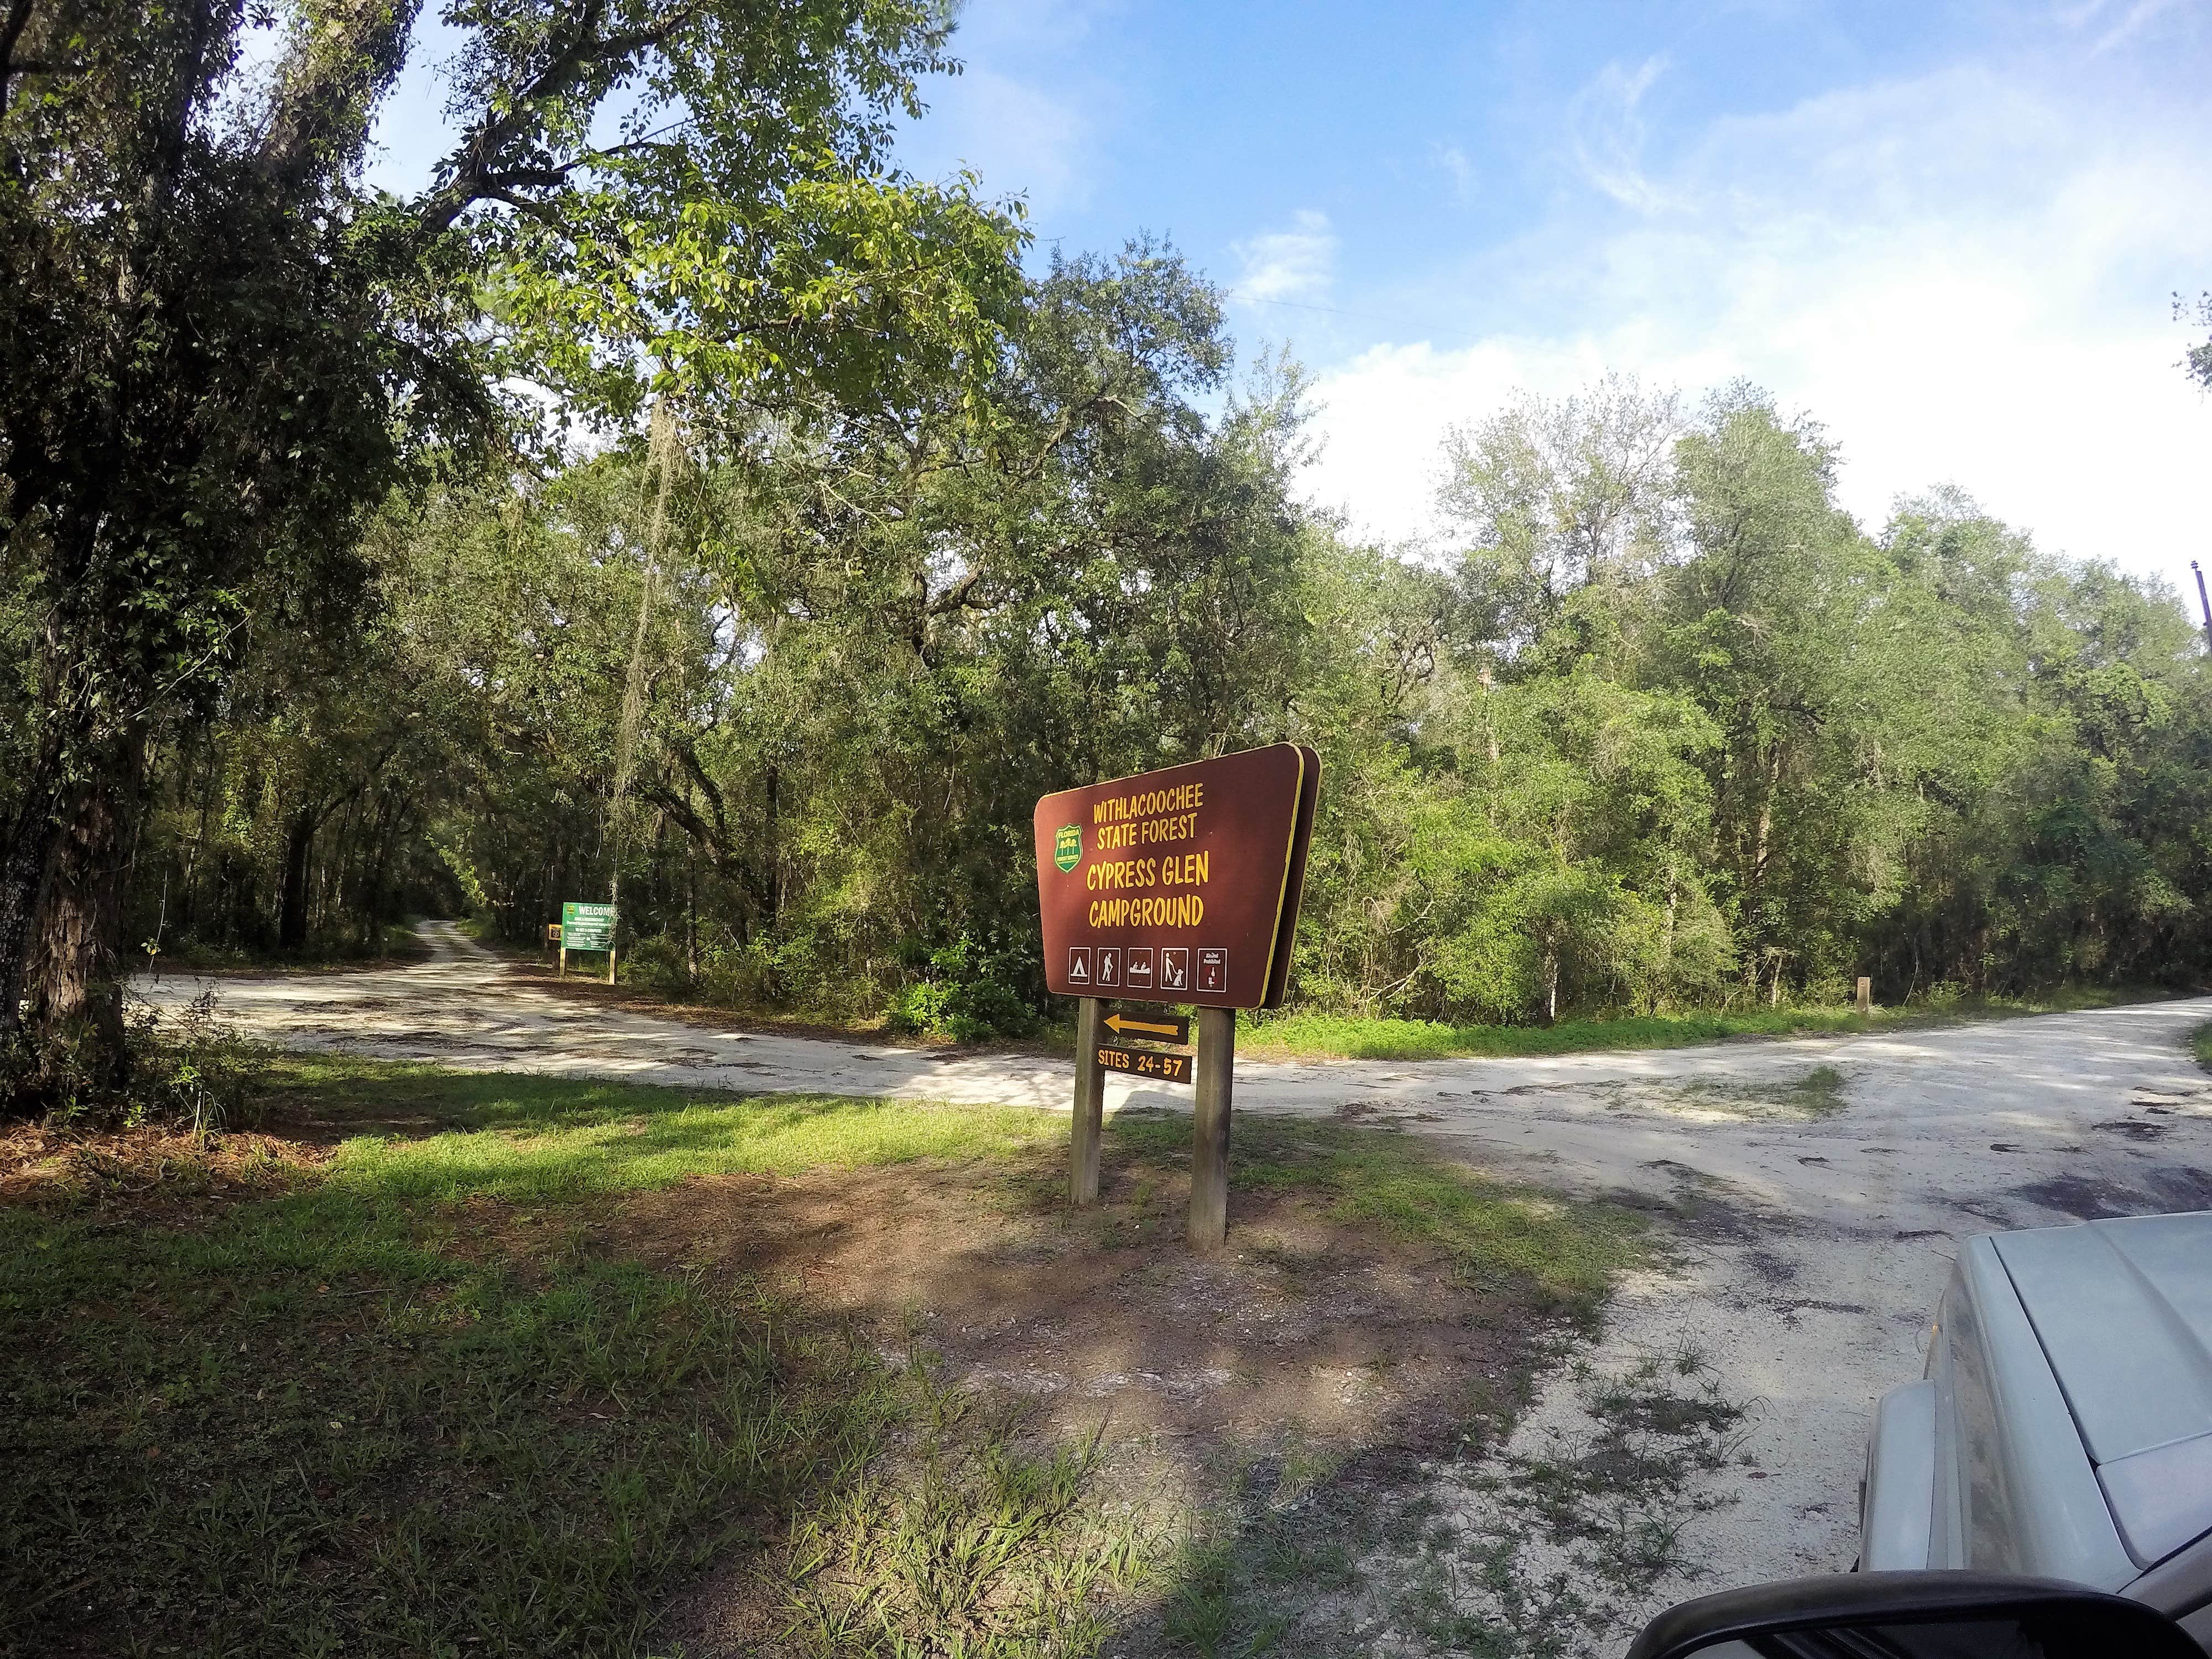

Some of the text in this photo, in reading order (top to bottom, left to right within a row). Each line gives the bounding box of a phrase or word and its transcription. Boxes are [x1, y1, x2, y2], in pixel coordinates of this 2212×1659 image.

[1093, 783, 1203, 824] WITHLACOOCHEE
[1058, 830, 1079, 838] FLORIDA
[1097, 813, 1197, 851] STATE FOREST
[1087, 850, 1209, 891] CYPRESS GLEN
[1089, 894, 1204, 928] CAMPGROUND
[1098, 1050, 1182, 1077] SITES 24-57
